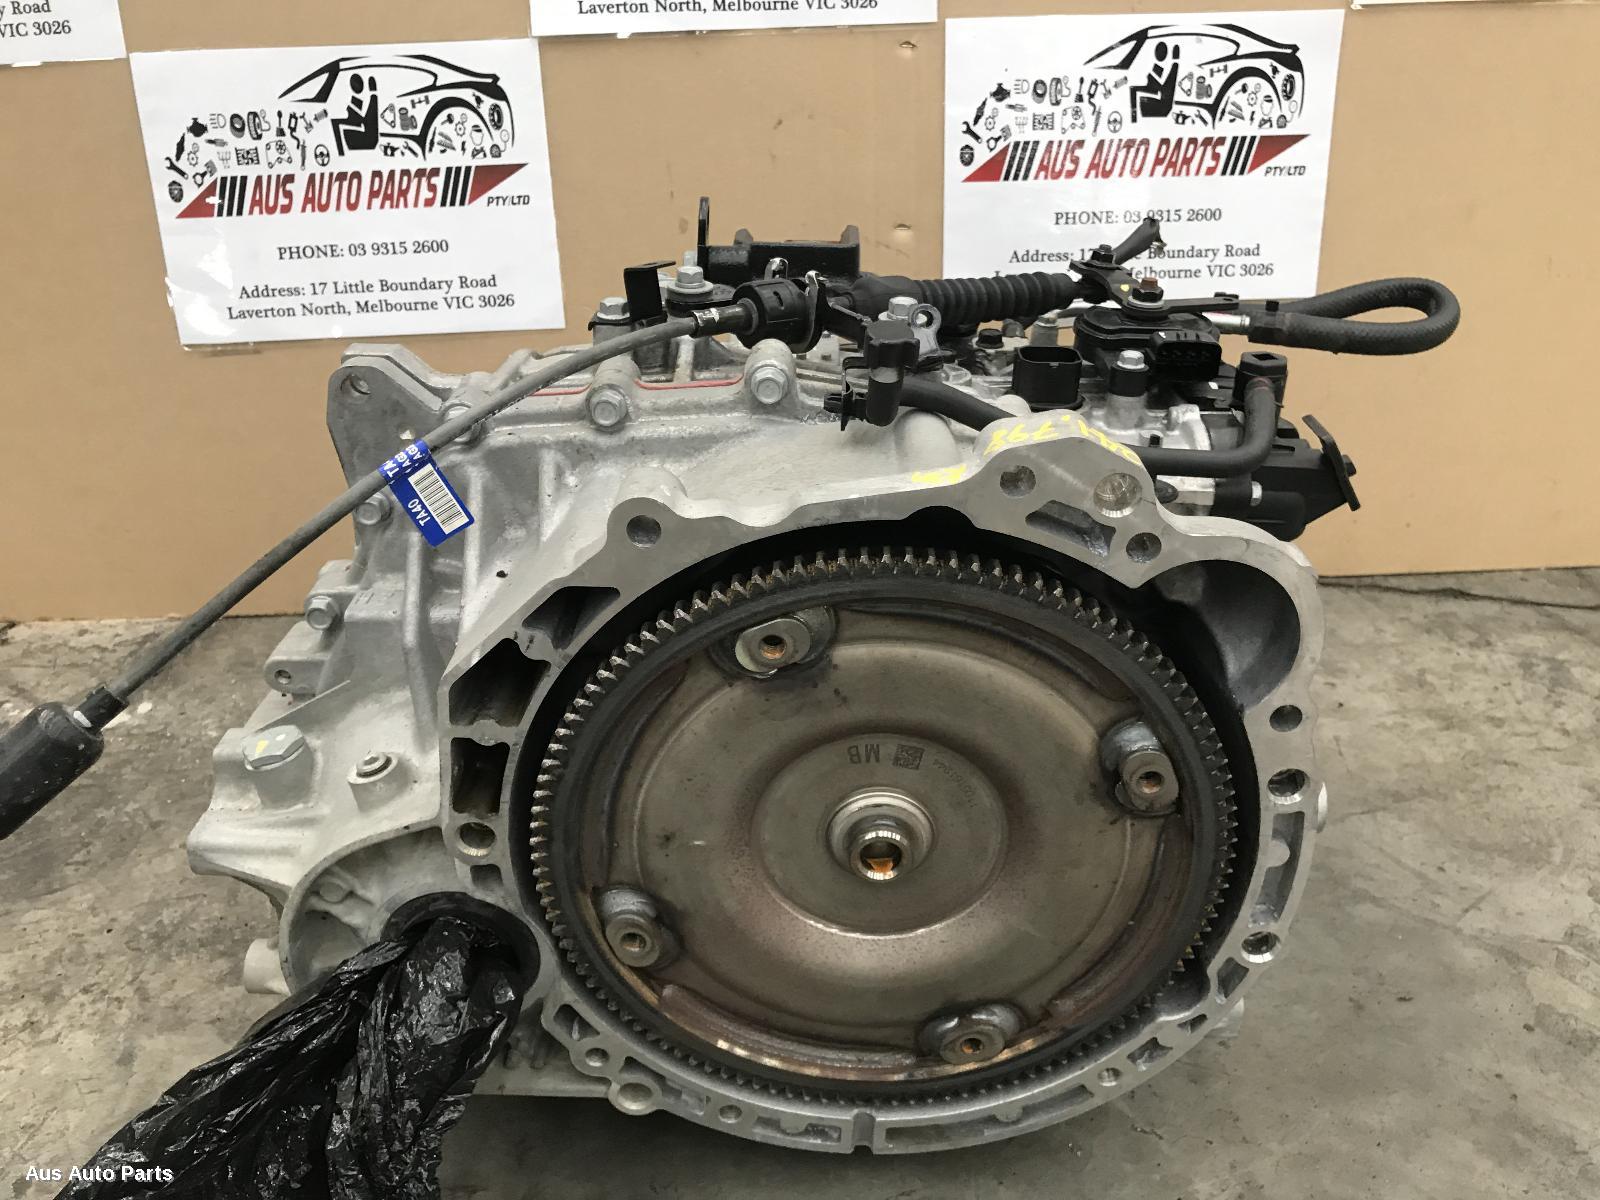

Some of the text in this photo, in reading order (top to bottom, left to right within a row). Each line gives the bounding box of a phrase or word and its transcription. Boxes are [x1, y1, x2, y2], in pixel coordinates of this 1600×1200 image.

[11, 0, 51, 15] Road
[578, 0, 649, 14] Laverton
[655, 0, 707, 14] North,
[712, 0, 799, 12] Melbourne
[805, 0, 836, 10] VIC
[32, 20, 71, 36] 3026
[1033, 135, 1227, 181] AUS AUTO PARTS
[248, 167, 441, 216] AUS AUTO PARTS
[1053, 210, 1119, 226] PHONE:
[1123, 210, 1141, 223] 03
[1186, 207, 1222, 222] 2600
[277, 239, 450, 260] PHONE: 03 9315 2600
[1009, 248, 1075, 264] Address:
[1224, 243, 1261, 258] Road
[1206, 264, 1235, 278] VIC
[1239, 263, 1274, 277] 3026
[239, 274, 498, 300] Address: 17 Little Boundary Road
[227, 294, 515, 321] Laverton North, Melbourne VIC 3026
[407, 499, 431, 527] TA40
[847, 743, 880, 764] MB
